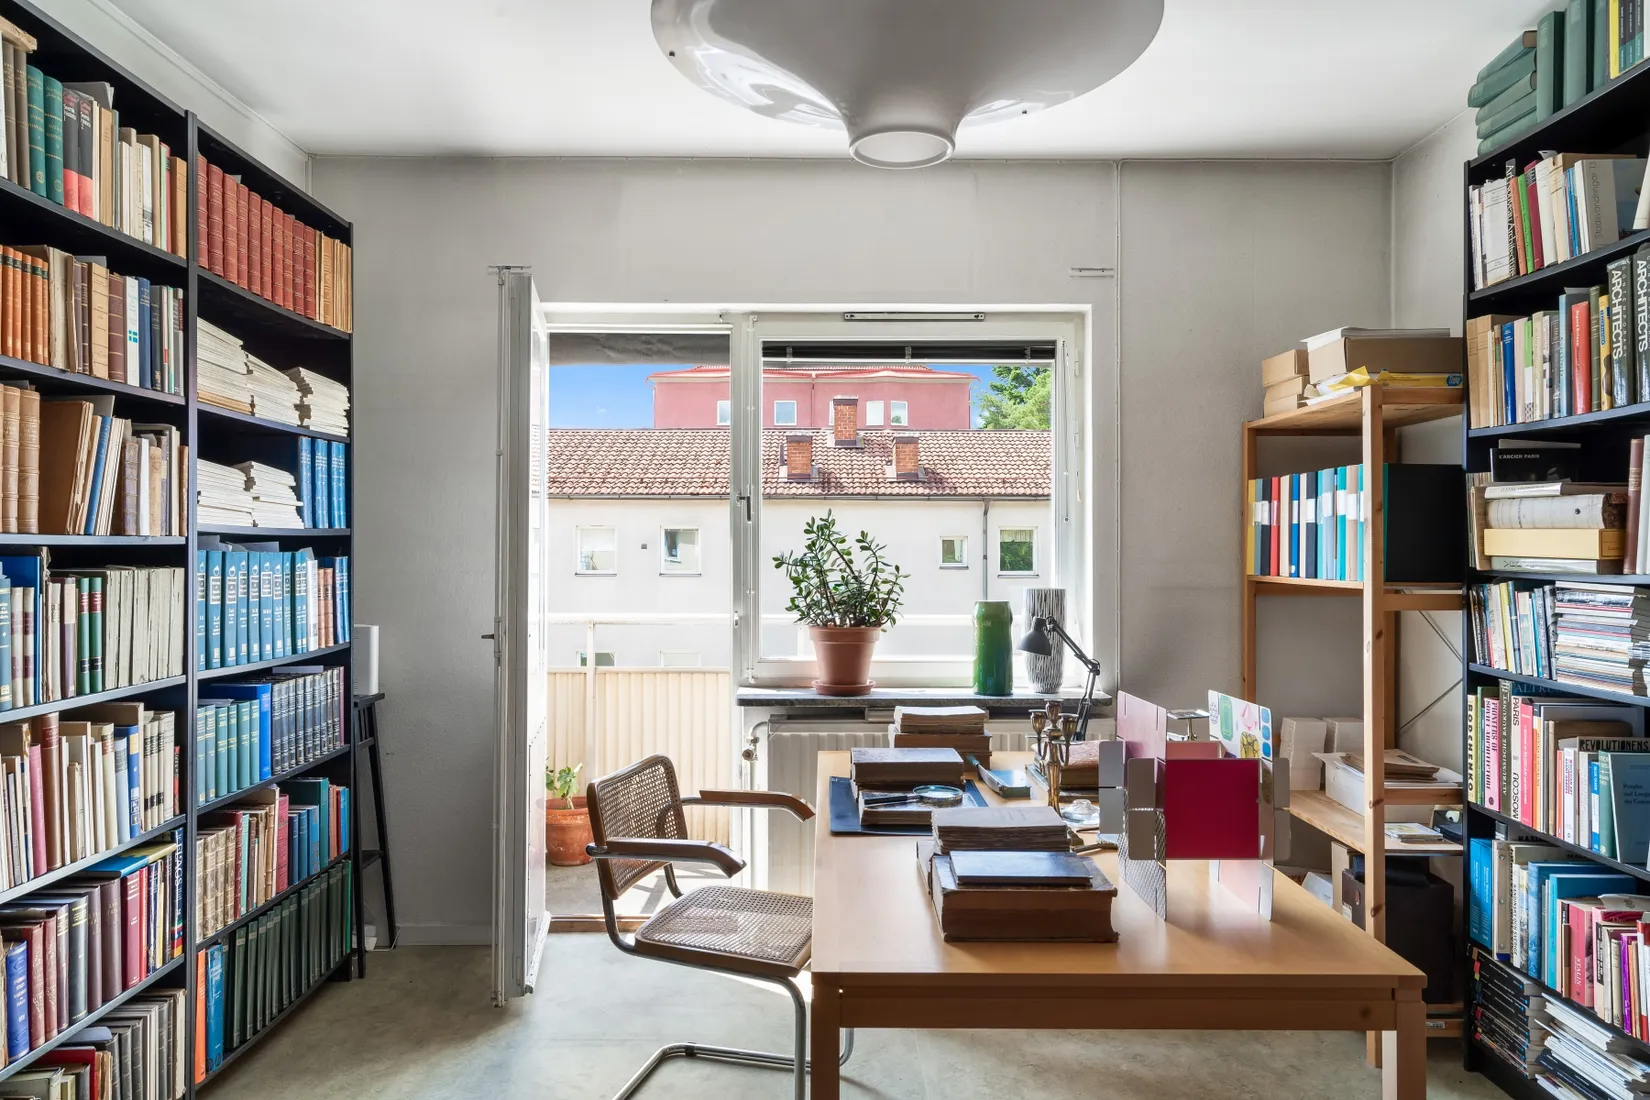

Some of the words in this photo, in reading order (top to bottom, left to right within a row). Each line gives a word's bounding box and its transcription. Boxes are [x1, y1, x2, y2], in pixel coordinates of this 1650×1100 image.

[1612, 270, 1623, 360] ARCHITECTS
[1637, 260, 1647, 352] ARCHITECTS
[1492, 742, 1497, 752] OF
[1580, 740, 1648, 751] REVOLUTIONENS
